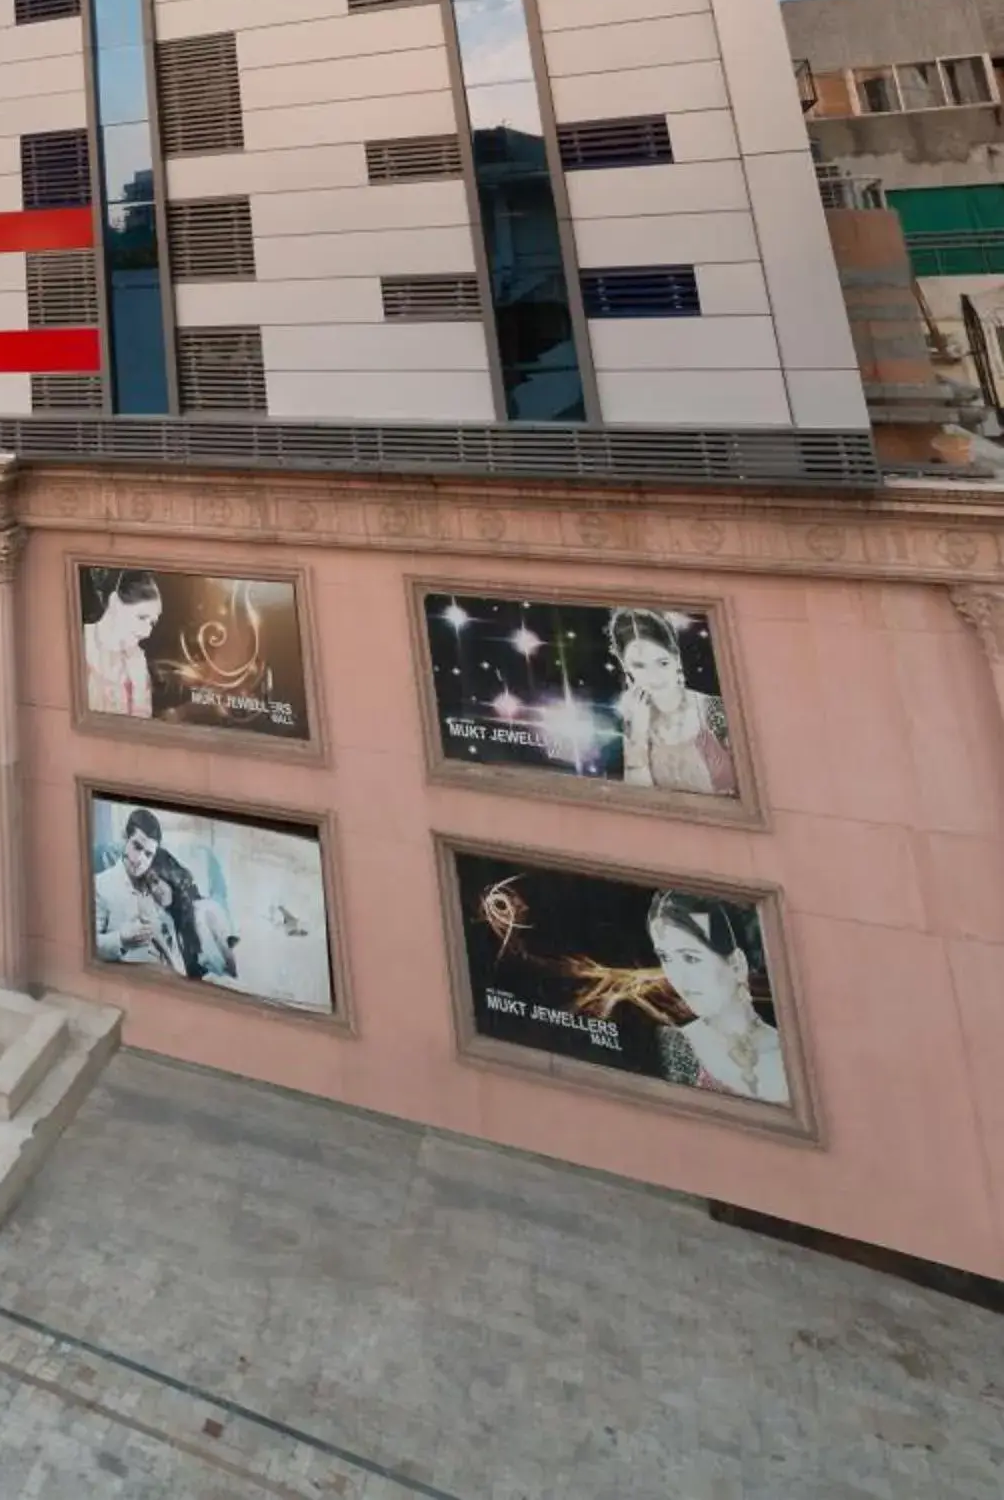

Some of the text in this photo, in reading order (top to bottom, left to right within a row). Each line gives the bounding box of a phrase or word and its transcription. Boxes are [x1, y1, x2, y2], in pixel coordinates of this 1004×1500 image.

[449, 723, 487, 740] MUKT
[487, 995, 619, 1037] MUKT JEWELLERS
[591, 1033, 623, 1051] MALL
